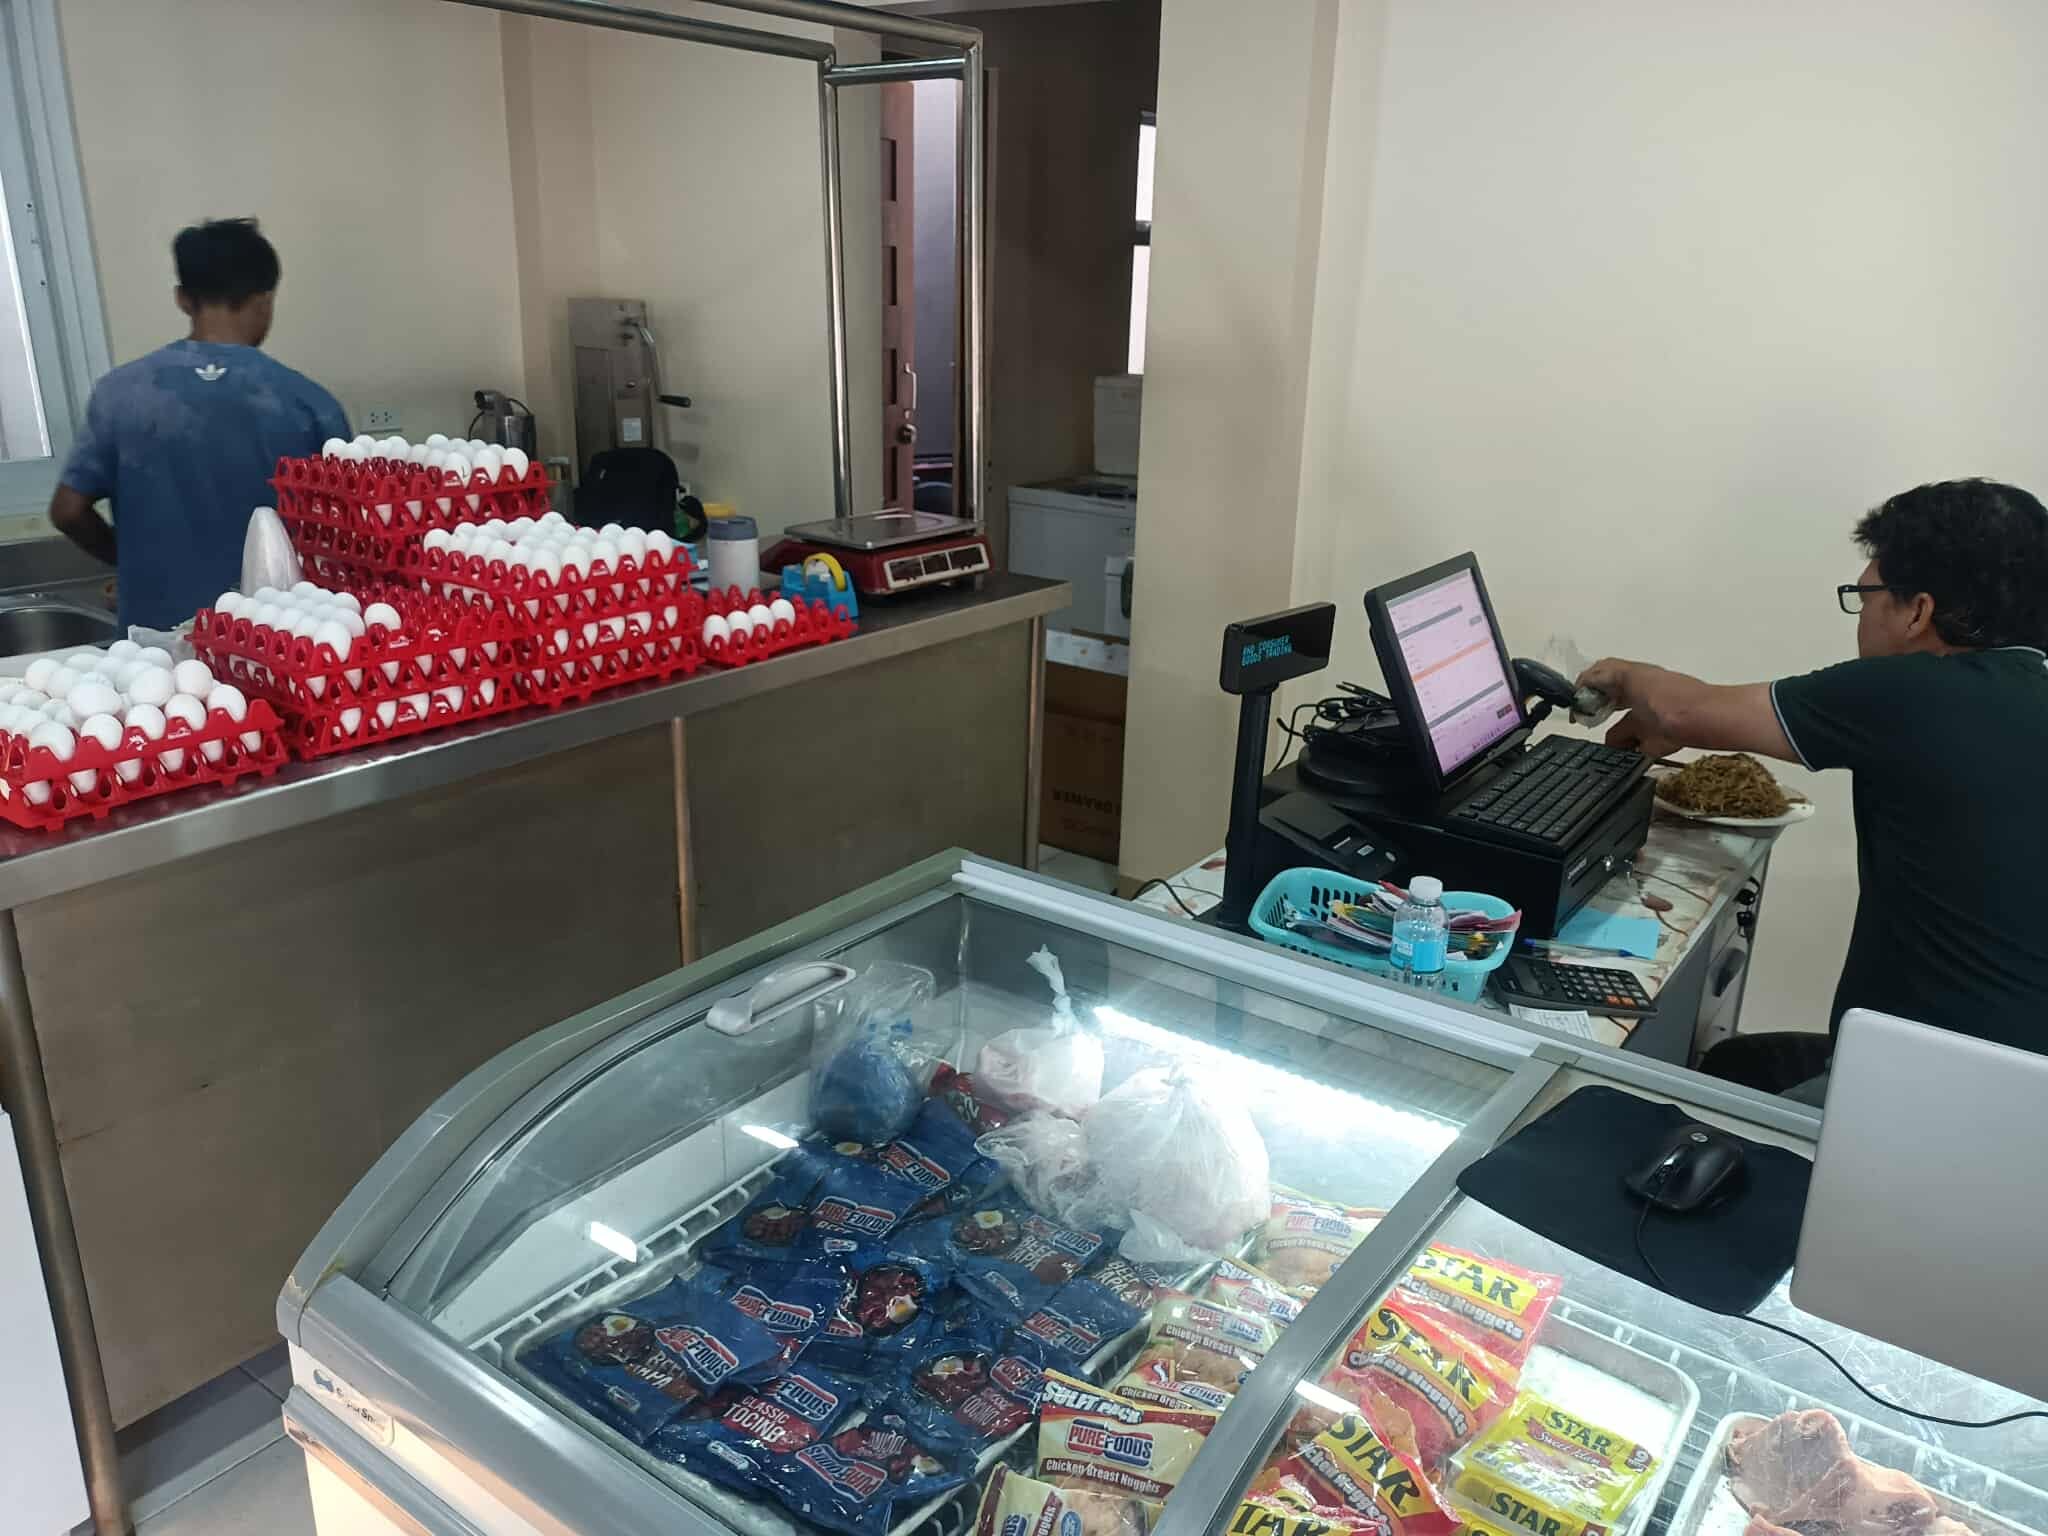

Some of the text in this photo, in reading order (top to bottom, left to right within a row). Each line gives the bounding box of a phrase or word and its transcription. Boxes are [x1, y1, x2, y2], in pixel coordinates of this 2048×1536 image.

[1415, 1254, 1520, 1311] STAR
[1453, 1291, 1525, 1340] Nuggets
[1370, 1307, 1480, 1402] STAR
[742, 1397, 790, 1424] CLASSIC
[1407, 1371, 1470, 1437] Nuggets
[1069, 1426, 1154, 1459] PUREFOODS
[1548, 1411, 1611, 1456] STAR
[1046, 1460, 1161, 1494] Chicken Breast Nuggets
[1327, 1413, 1420, 1506] STAR
[1230, 1503, 1330, 1536] TAR
[1489, 1492, 1561, 1536] STAR
